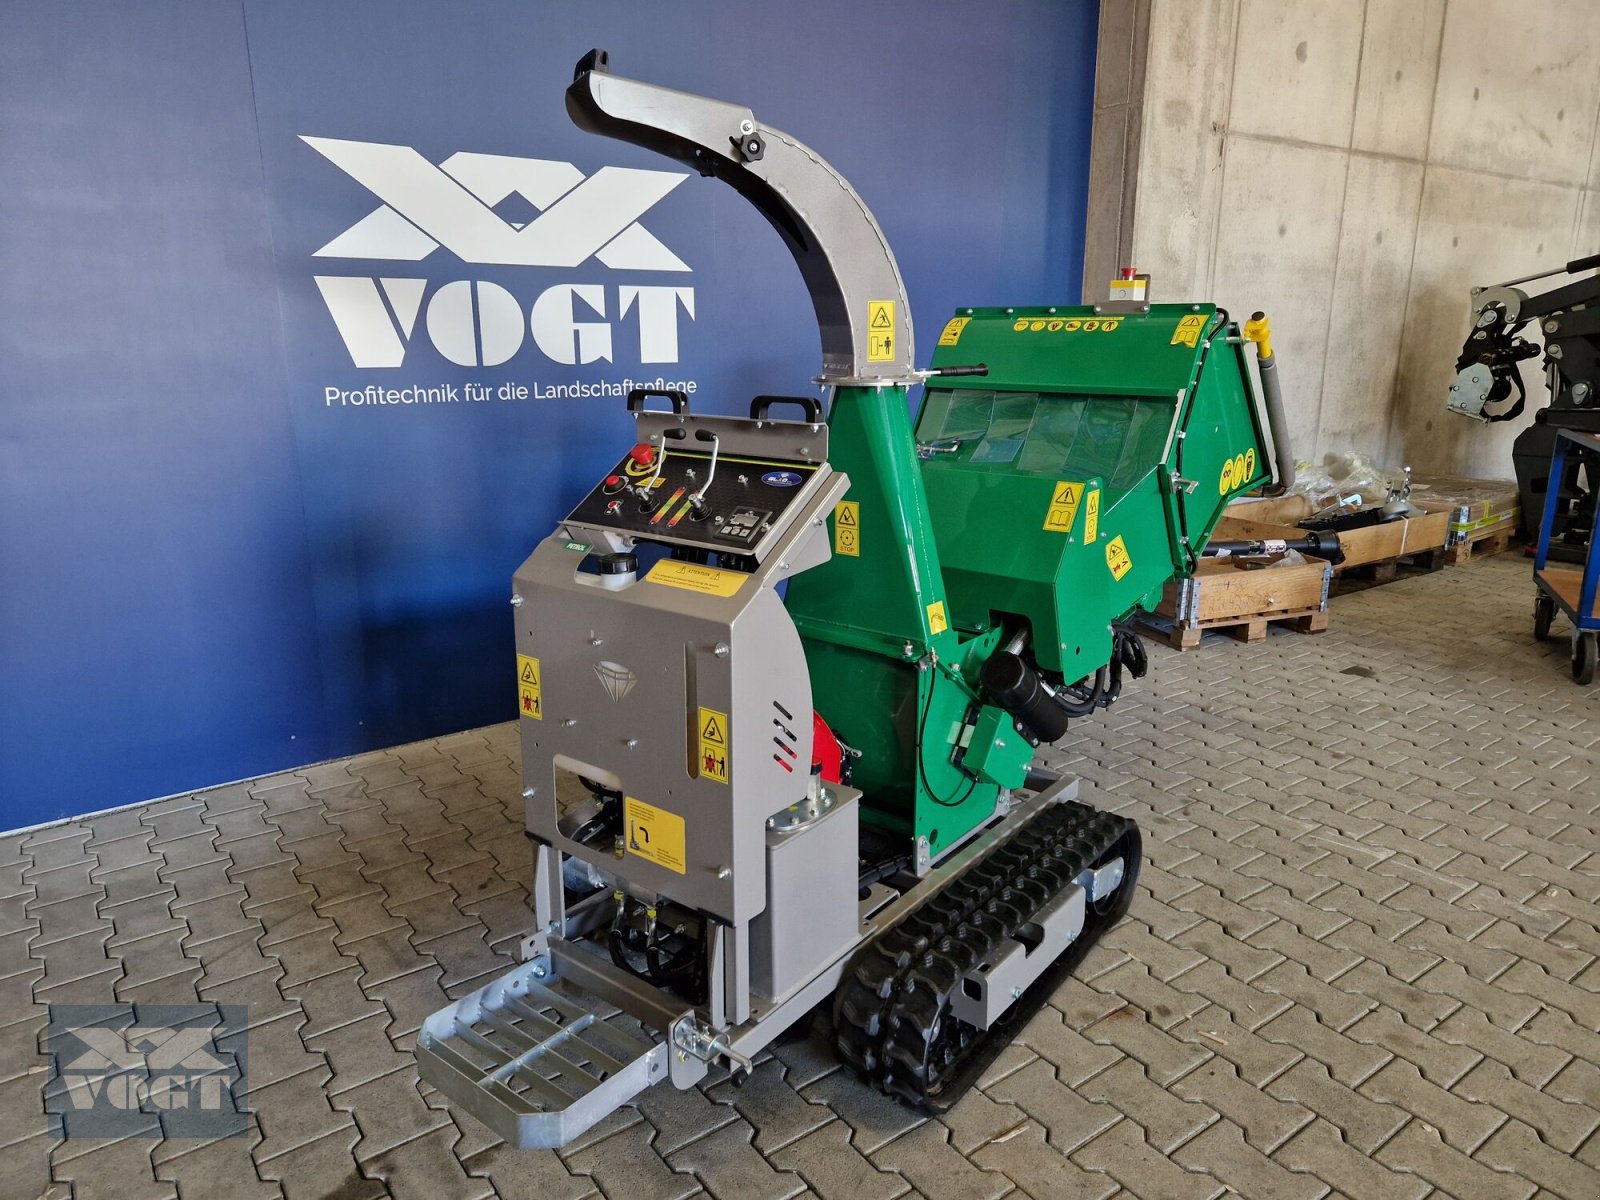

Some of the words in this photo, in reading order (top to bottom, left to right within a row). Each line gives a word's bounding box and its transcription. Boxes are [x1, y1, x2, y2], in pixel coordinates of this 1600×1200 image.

[313, 275, 695, 368] VOGT
[325, 383, 460, 407] Profitechnik
[464, 382, 495, 403] für
[498, 381, 528, 402] die
[839, 545, 855, 553] STOP
